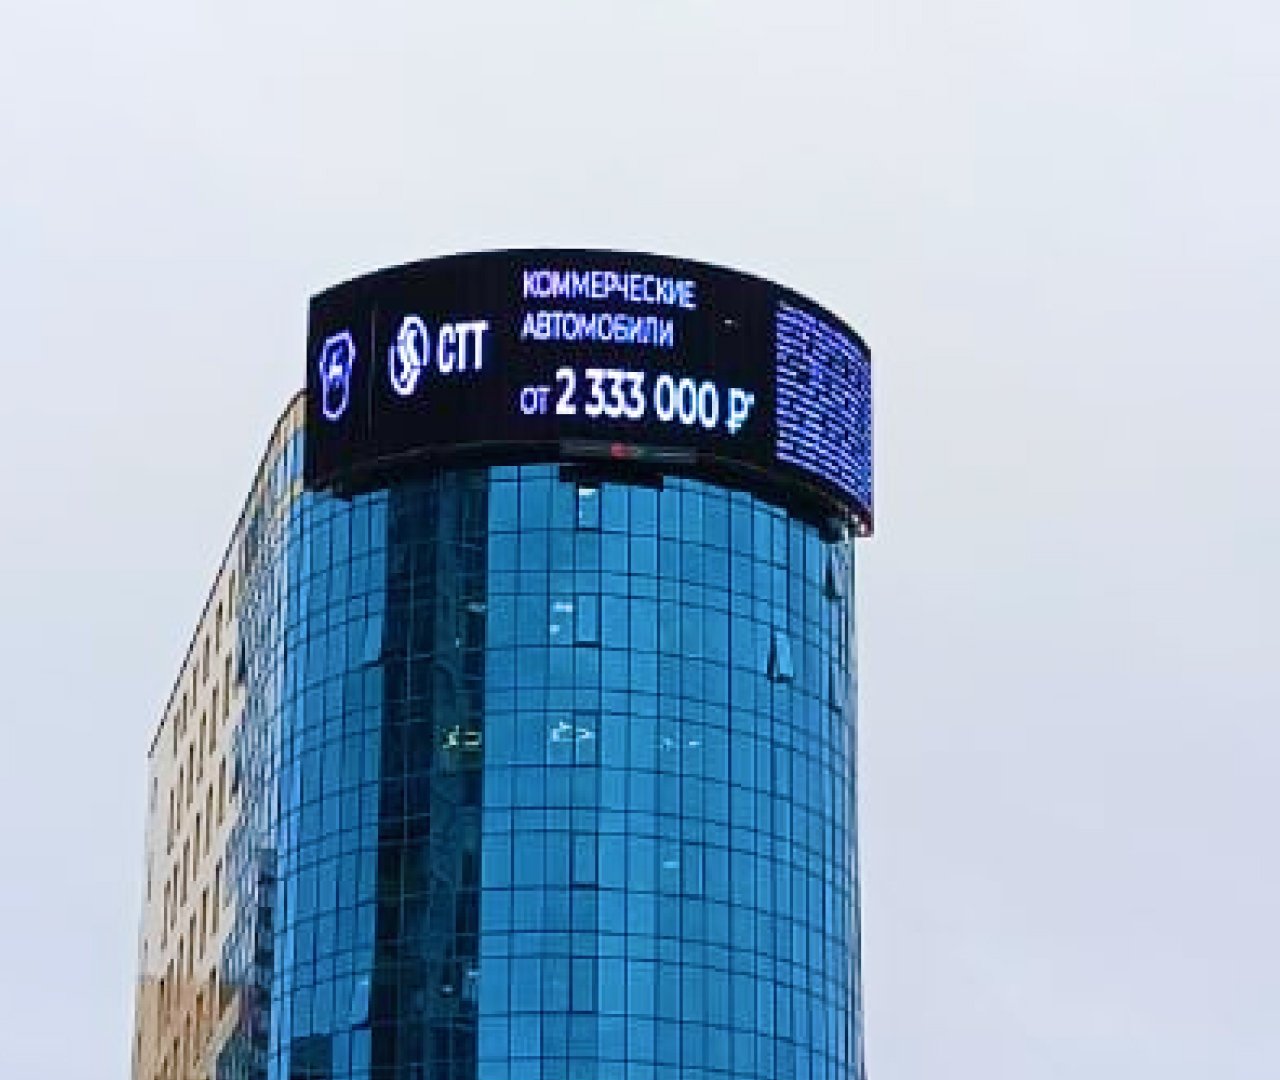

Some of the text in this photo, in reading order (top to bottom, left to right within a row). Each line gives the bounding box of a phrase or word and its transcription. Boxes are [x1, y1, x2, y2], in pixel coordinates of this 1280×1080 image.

[523, 271, 696, 309] КОММЕРЧЕСКИЕ
[438, 321, 487, 374] СТТ
[522, 311, 673, 346] АВТОМОБИЛИ
[556, 367, 576, 414] 2
[585, 368, 644, 417] 333
[656, 375, 718, 427] 000
